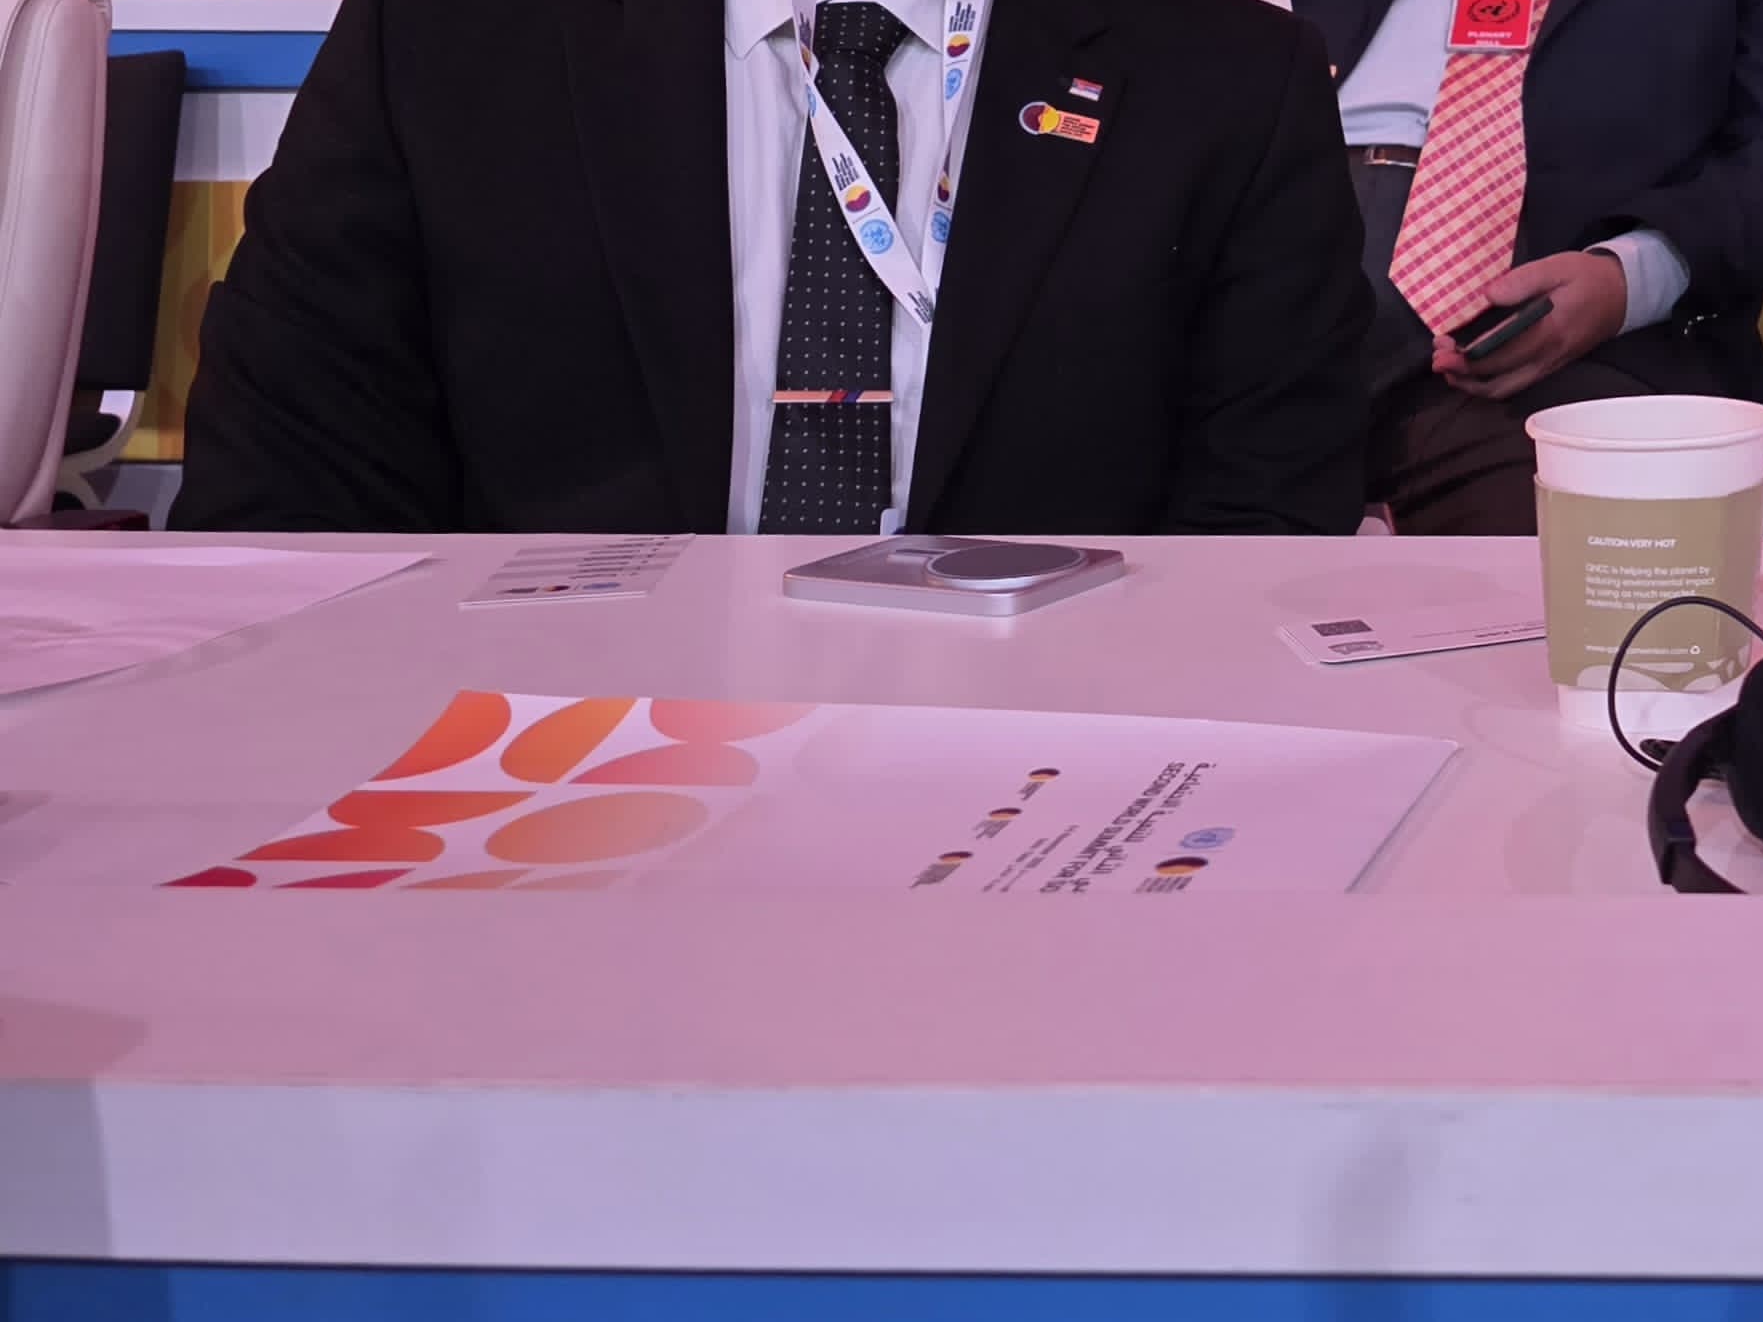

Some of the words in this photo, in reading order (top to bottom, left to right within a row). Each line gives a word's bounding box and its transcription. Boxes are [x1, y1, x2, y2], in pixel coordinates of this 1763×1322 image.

[1630, 538, 1653, 549] VERY
[1655, 538, 1677, 549] HOT
[1620, 566, 1652, 577] helping
[1654, 566, 1667, 574] the
[1699, 565, 1711, 575] by
[1633, 589, 1657, 598] much
[1141, 761, 1185, 797] SECOND
[1112, 797, 1153, 825] WORLD
[1079, 826, 1124, 860] SUMMIT
[1055, 861, 1088, 879] FOR
